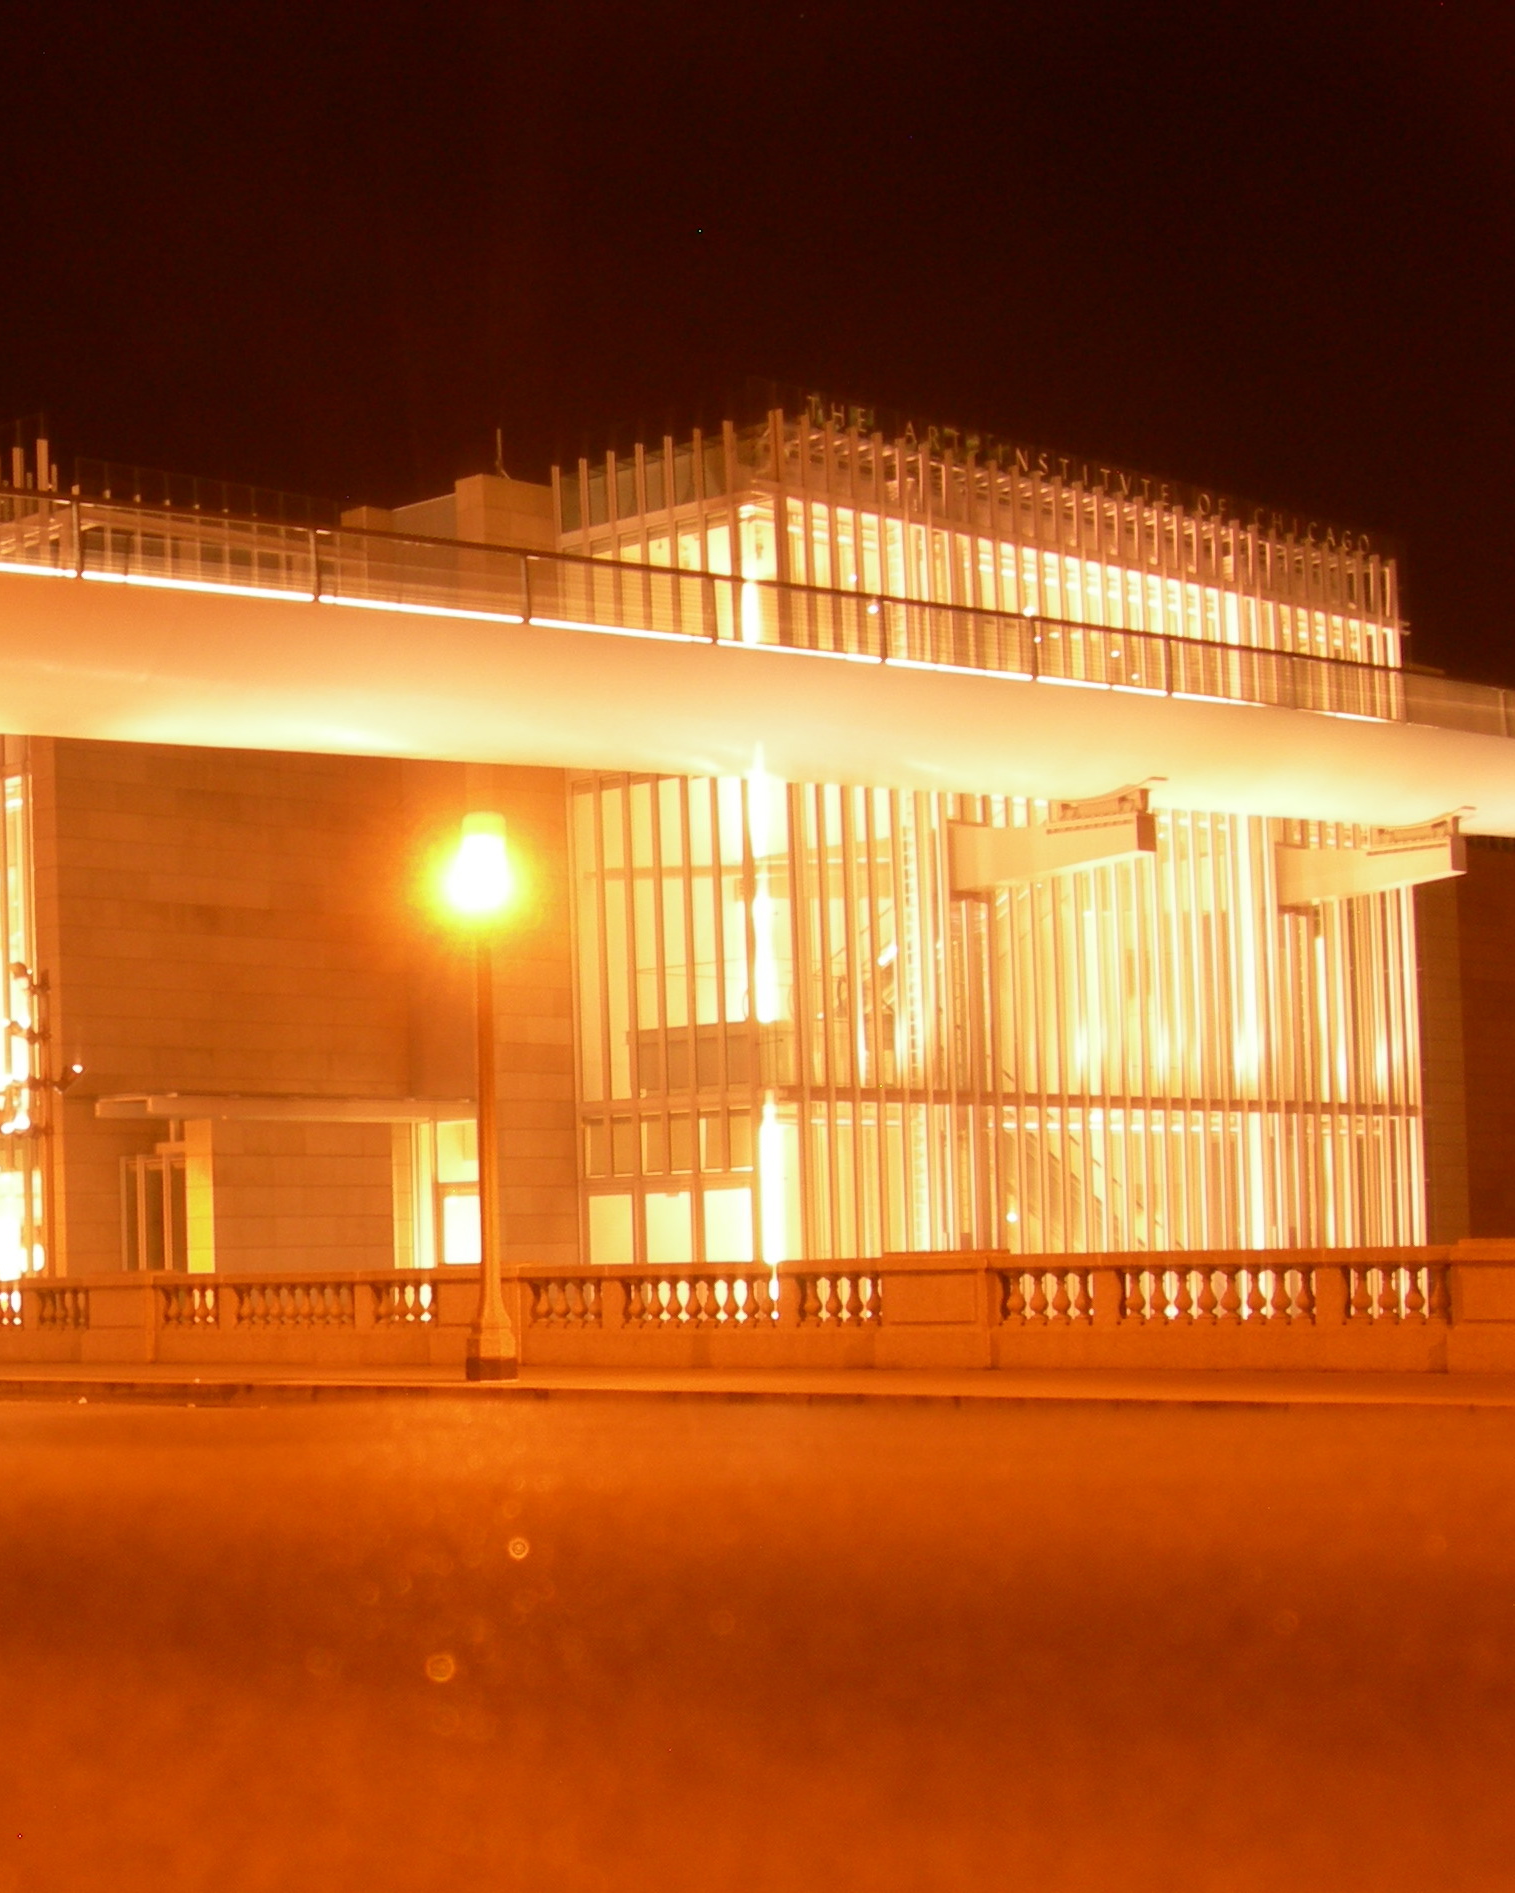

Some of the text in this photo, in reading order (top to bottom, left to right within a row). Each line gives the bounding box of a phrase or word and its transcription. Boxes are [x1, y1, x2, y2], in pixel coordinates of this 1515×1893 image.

[806, 394, 867, 433] THE
[905, 420, 960, 451] ART
[1197, 493, 1227, 518] OF
[1253, 507, 1371, 552] CHICAGO
